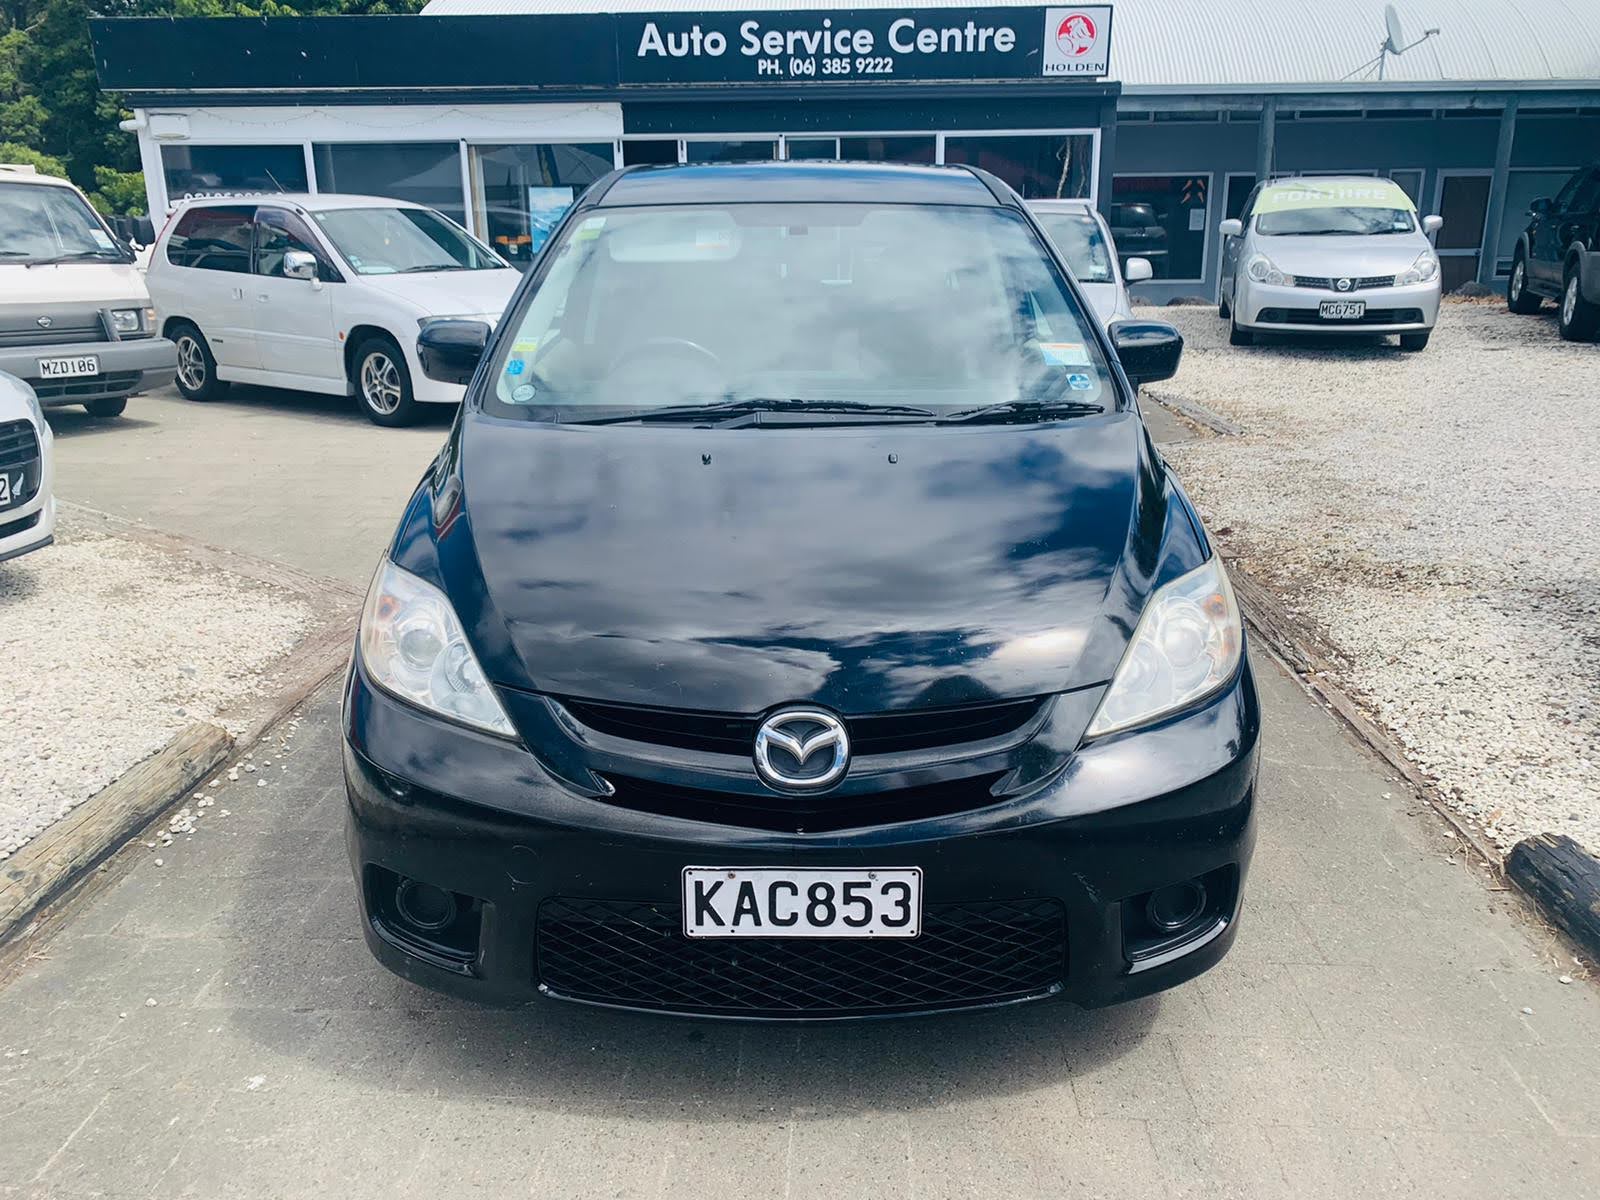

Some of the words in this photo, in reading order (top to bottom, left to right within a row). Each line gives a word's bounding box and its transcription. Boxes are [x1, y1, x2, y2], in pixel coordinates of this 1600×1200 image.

[637, 22, 727, 57] Auto
[740, 18, 874, 56] Service
[888, 18, 1016, 54] Centre
[758, 58, 784, 75] PH.
[789, 57, 816, 76] (06)
[821, 57, 851, 75] 385
[855, 57, 894, 74] 9222
[1045, 63, 1105, 72] HOLDEN
[1320, 304, 1362, 315] MCG751
[41, 360, 96, 375] MZD106
[694, 880, 912, 928] KAC853
